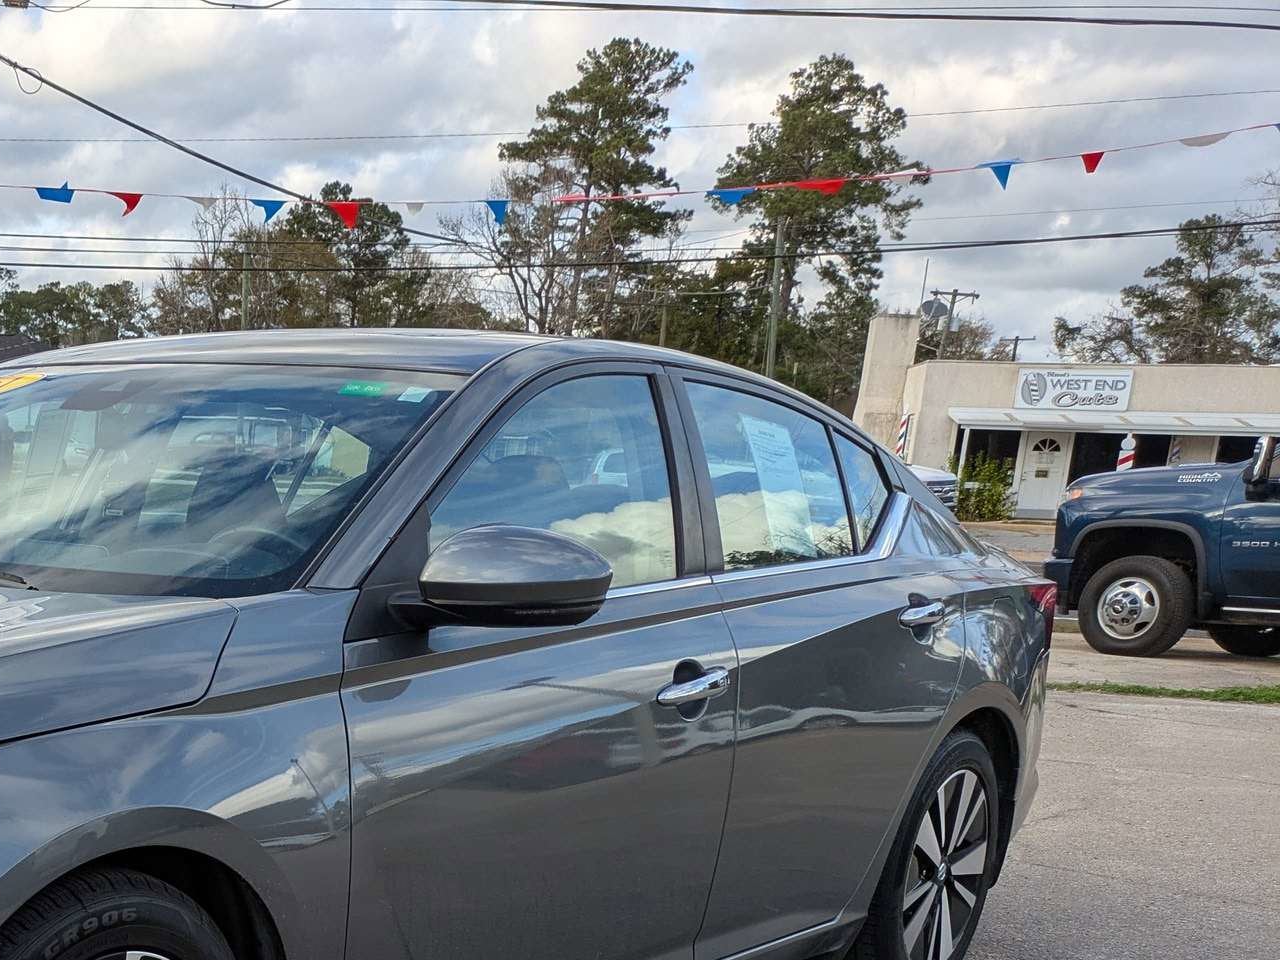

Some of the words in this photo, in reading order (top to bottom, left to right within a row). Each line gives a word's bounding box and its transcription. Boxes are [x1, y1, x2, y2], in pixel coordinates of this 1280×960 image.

[1050, 379, 1091, 391] WEST
[1094, 379, 1127, 391] END
[1052, 391, 1119, 408] Cuts
